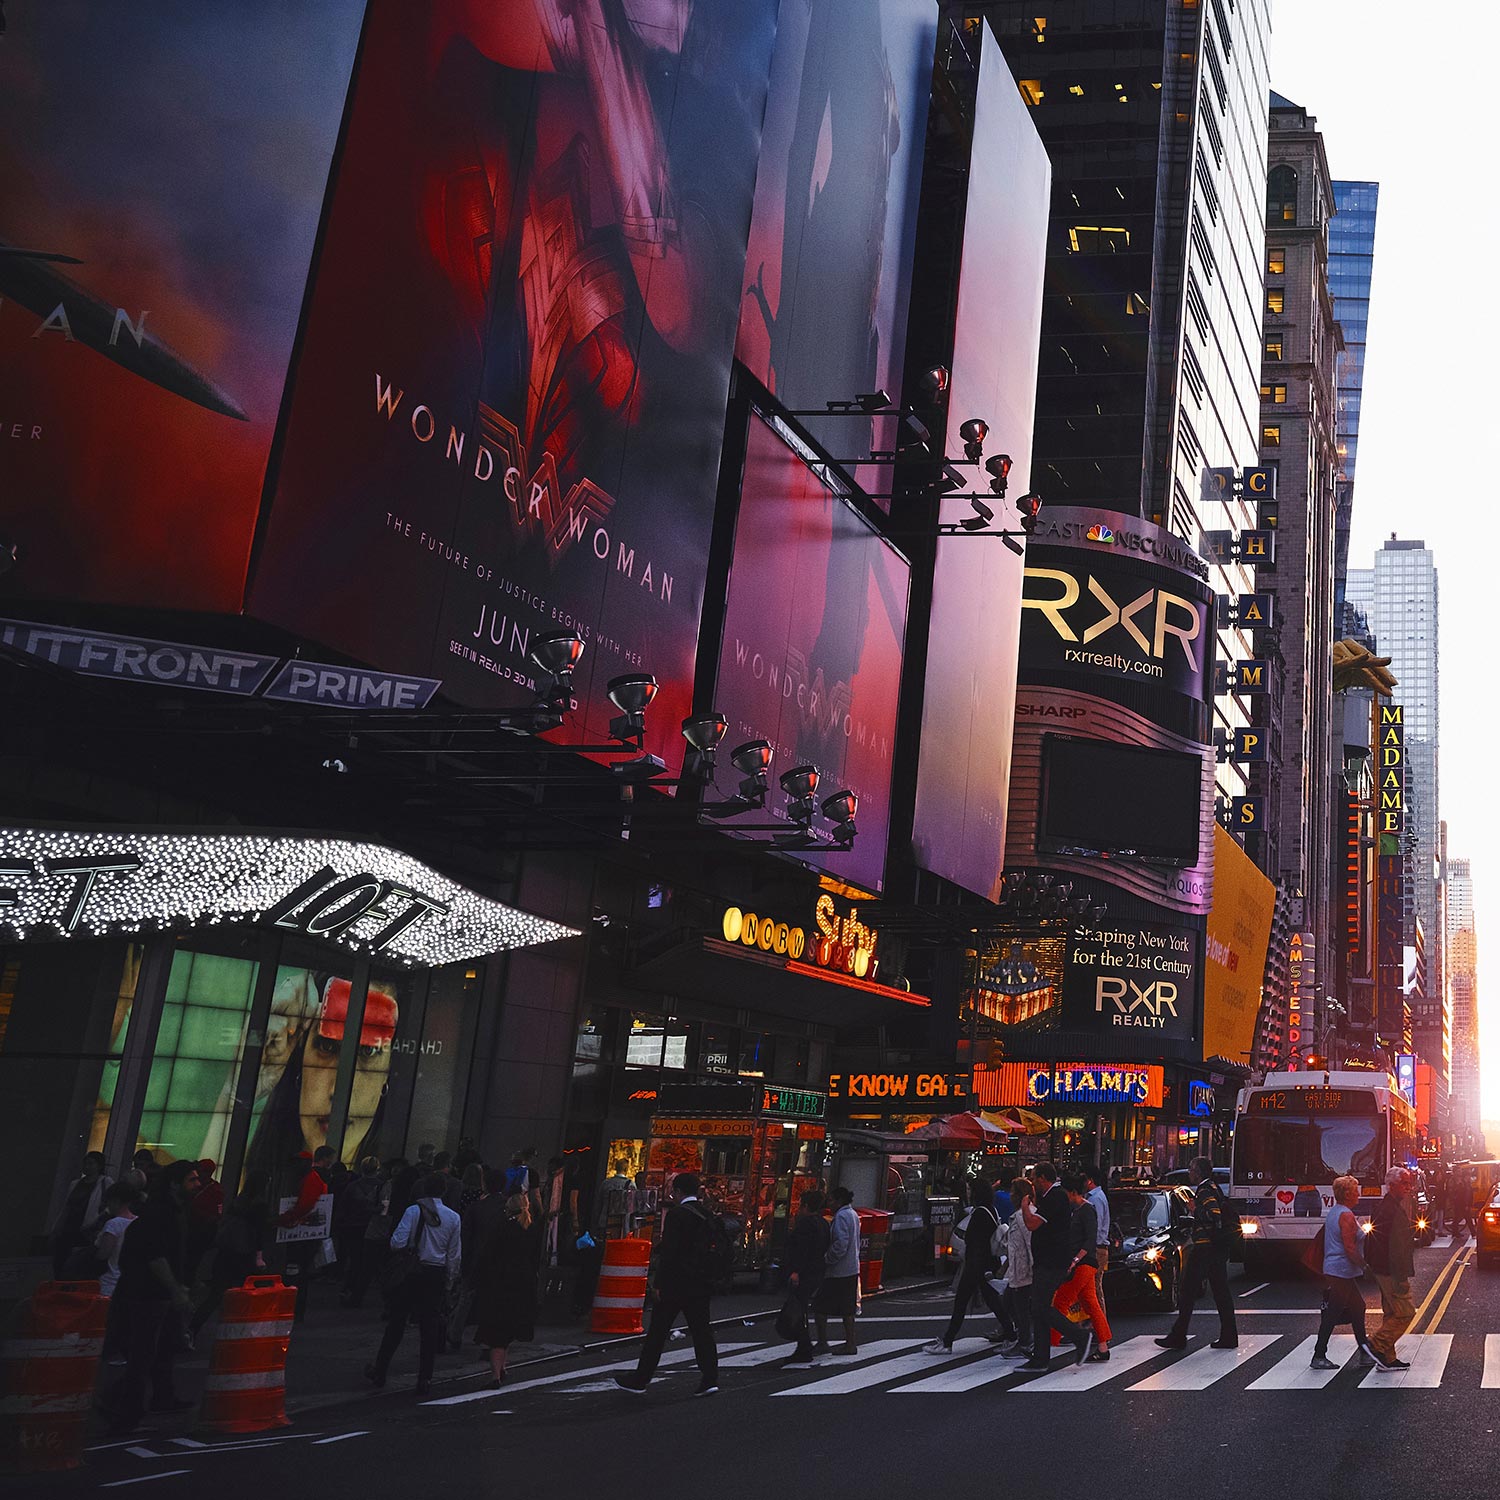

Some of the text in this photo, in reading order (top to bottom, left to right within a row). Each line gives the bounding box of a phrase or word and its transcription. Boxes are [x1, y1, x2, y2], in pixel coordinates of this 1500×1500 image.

[0, 298, 152, 349] AN
[0, 422, 42, 440] ER
[374, 372, 674, 605] WONDER WOMAN
[385, 511, 643, 668] THE FUTURE OF JUSTICE BEGINS WITH HER
[472, 604, 538, 659] JUN
[1020, 566, 1202, 674] RXR
[1065, 647, 1164, 678] rxrrealty.com
[1241, 472, 1268, 825] CHAMPS
[289, 667, 421, 709] PRIME
[735, 638, 890, 760] WONDER WOMAN
[1015, 703, 1087, 719] SHARP
[1380, 706, 1403, 831] MADAME
[1168, 878, 1204, 897] AQUOS
[271, 867, 449, 952] LOFT
[1074, 924, 1190, 952] Shaping New York
[1072, 948, 1192, 979] for the 21st Century
[1095, 975, 1179, 1018] RXR
[1287, 933, 1303, 1072] AMSTERDA
[1112, 1014, 1166, 1029] REALTY
[778, 1091, 819, 1115] WATER
[847, 1073, 910, 1097] KNOW
[1028, 1070, 1149, 1100] CHAMPS
[1260, 1092, 1342, 1109] M42 EAST SIDE
[654, 1123, 751, 1133] HALAL FOOD
